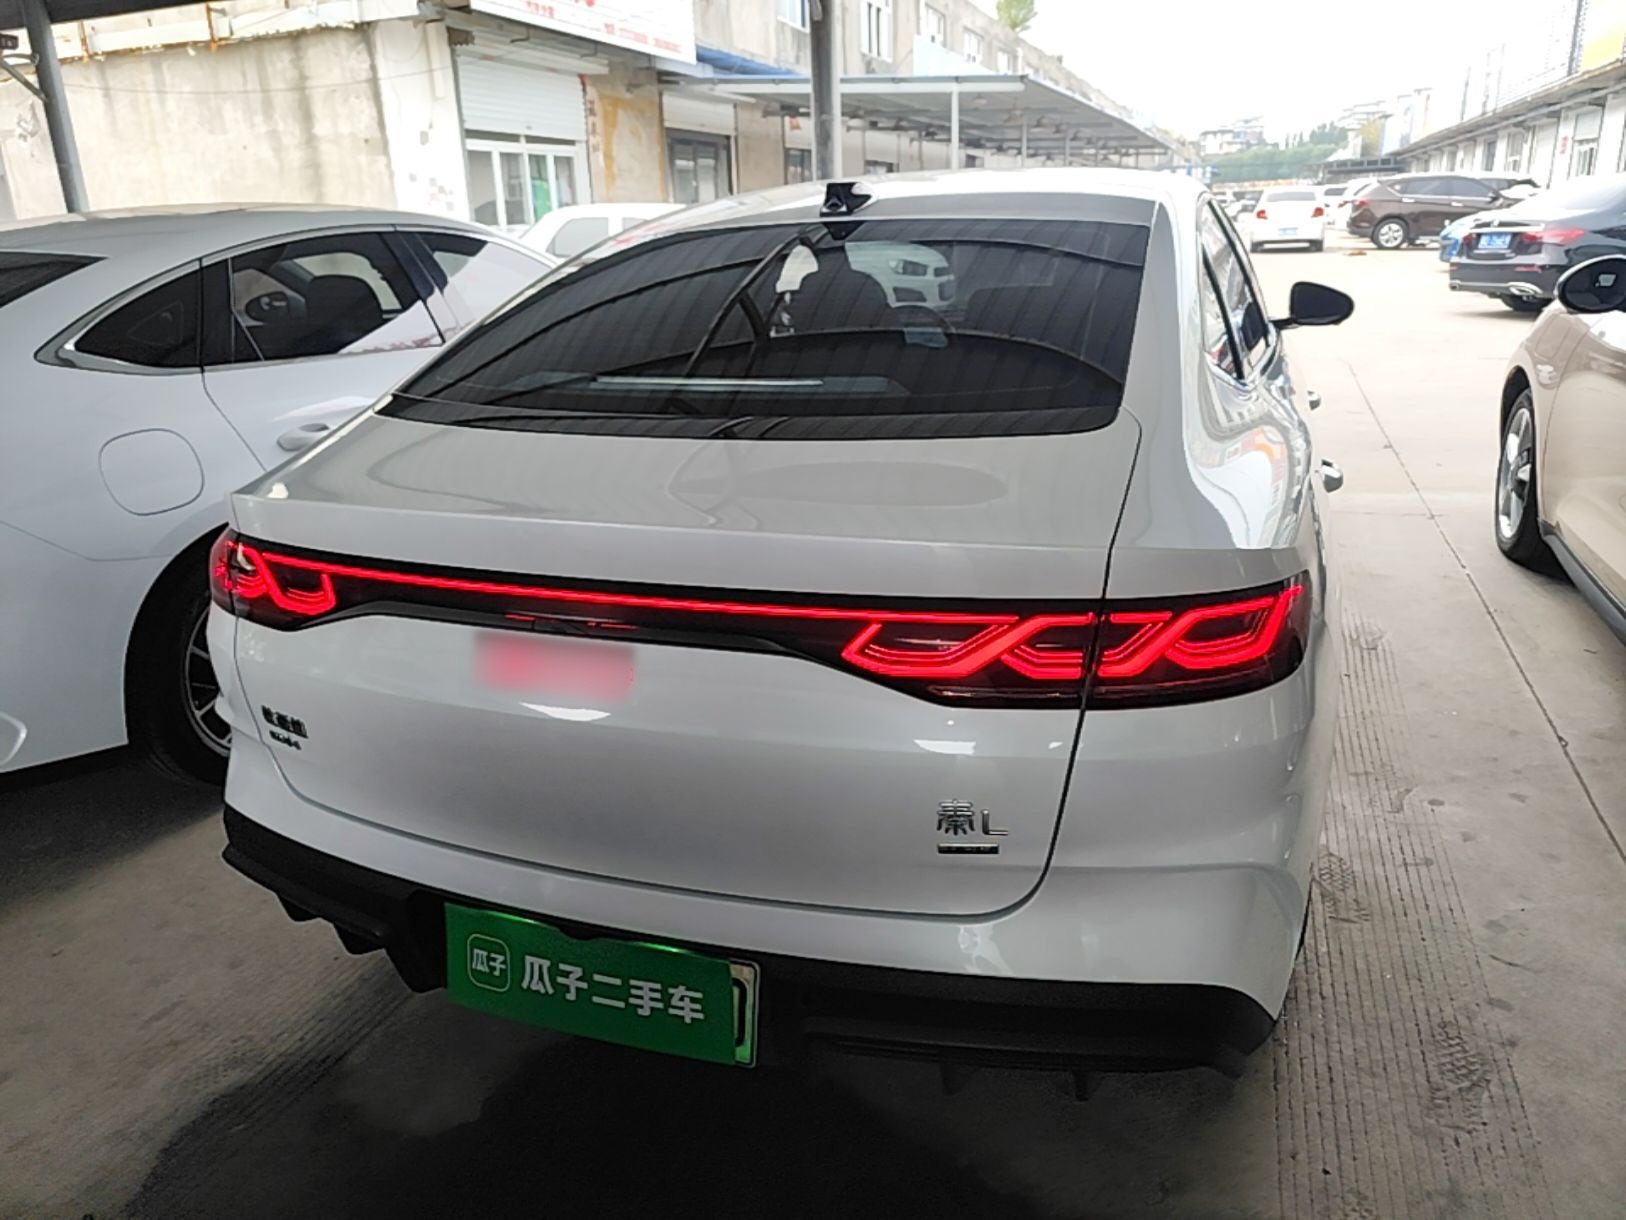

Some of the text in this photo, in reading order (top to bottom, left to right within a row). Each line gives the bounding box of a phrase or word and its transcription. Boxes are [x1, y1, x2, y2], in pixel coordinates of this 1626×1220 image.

[471, 948, 705, 1024] 瓜子 瓜子二手车
